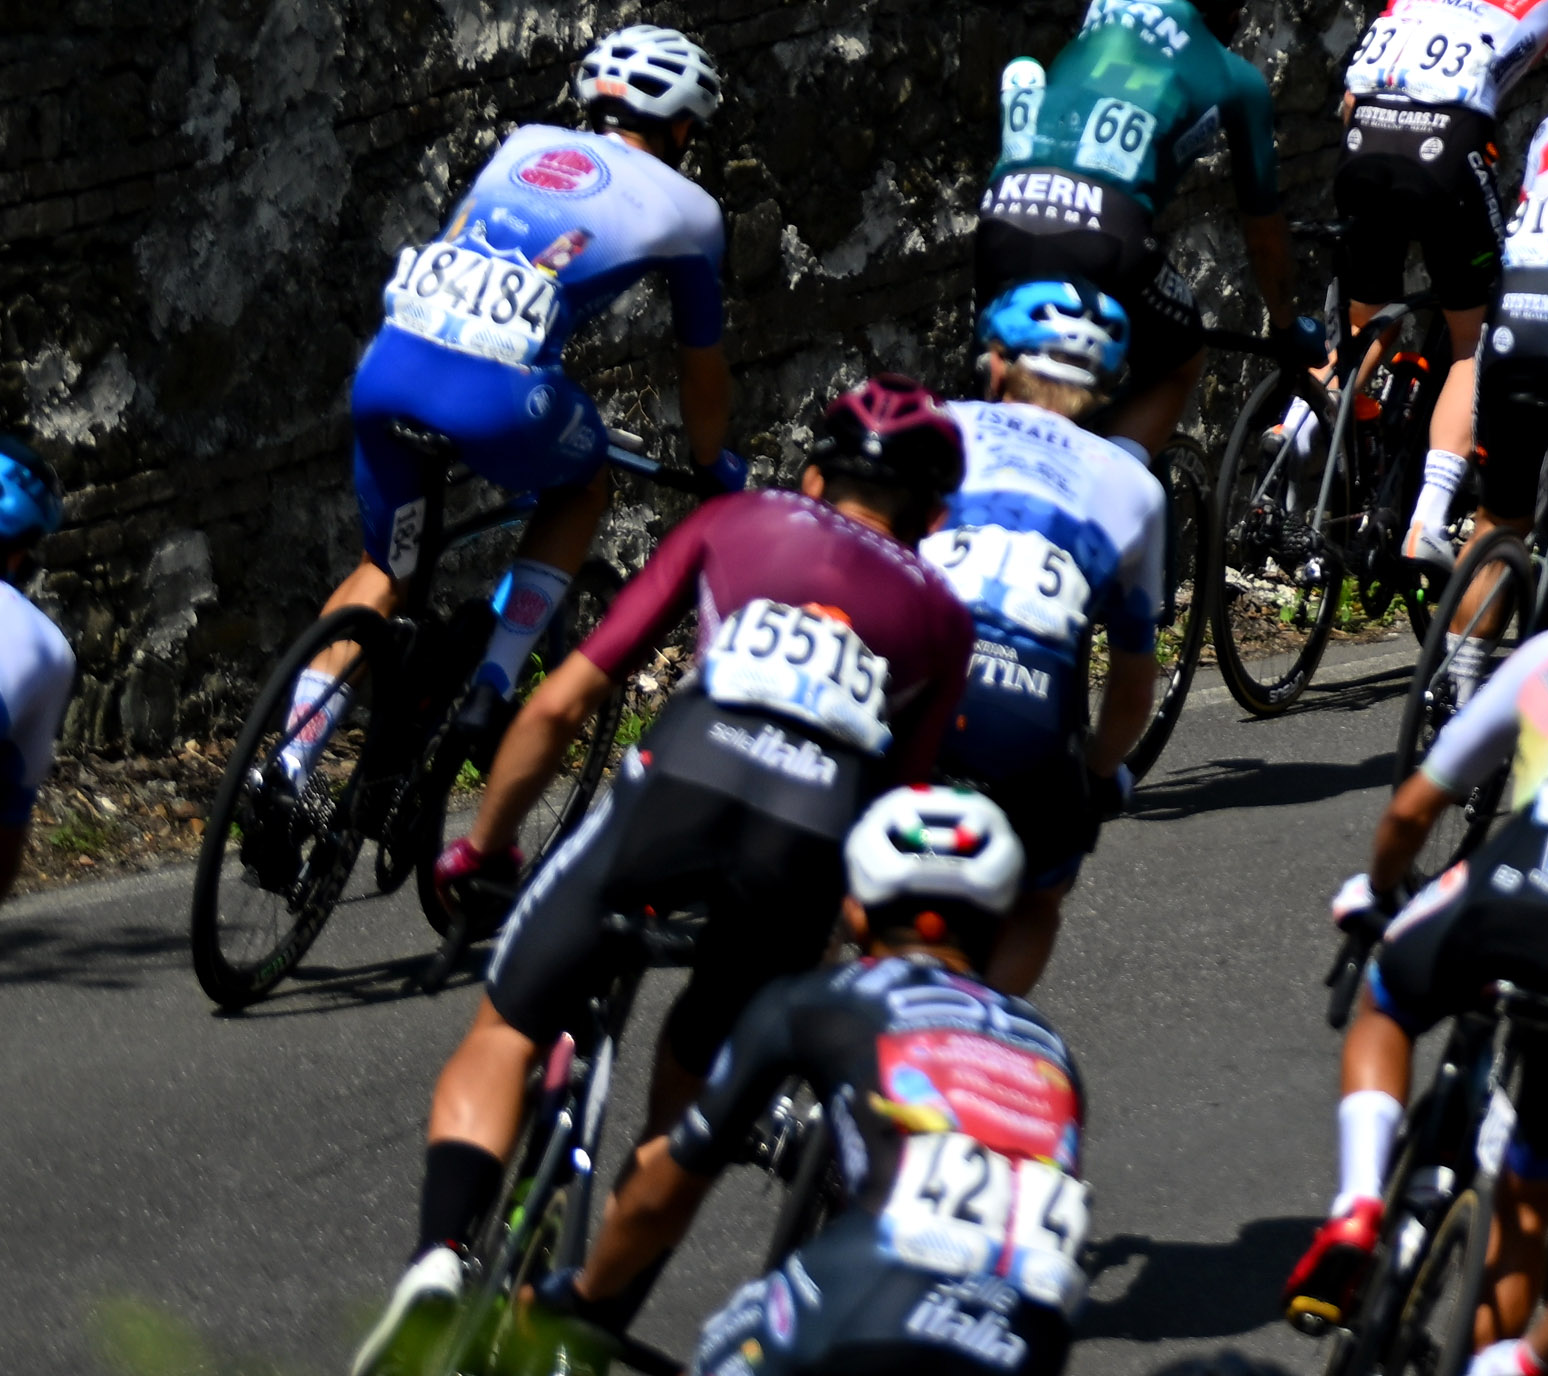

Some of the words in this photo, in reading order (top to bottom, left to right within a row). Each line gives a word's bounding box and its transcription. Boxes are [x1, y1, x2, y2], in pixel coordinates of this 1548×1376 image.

[1418, 33, 1473, 79] 93
[1094, 102, 1147, 153] 66
[1354, 105, 1399, 122] SYSTEM
[1399, 108, 1452, 131] CARS.IT
[993, 203, 1102, 231] PHARMA
[998, 173, 1104, 215] KERN
[397, 248, 468, 309] 184
[976, 408, 1072, 450] ISRAEL
[942, 526, 973, 569] 5
[1039, 547, 1067, 598] 5
[829, 629, 874, 705] 15
[751, 723, 838, 789] italia
[917, 1134, 992, 1225] 42
[904, 1291, 1029, 1369] italia
